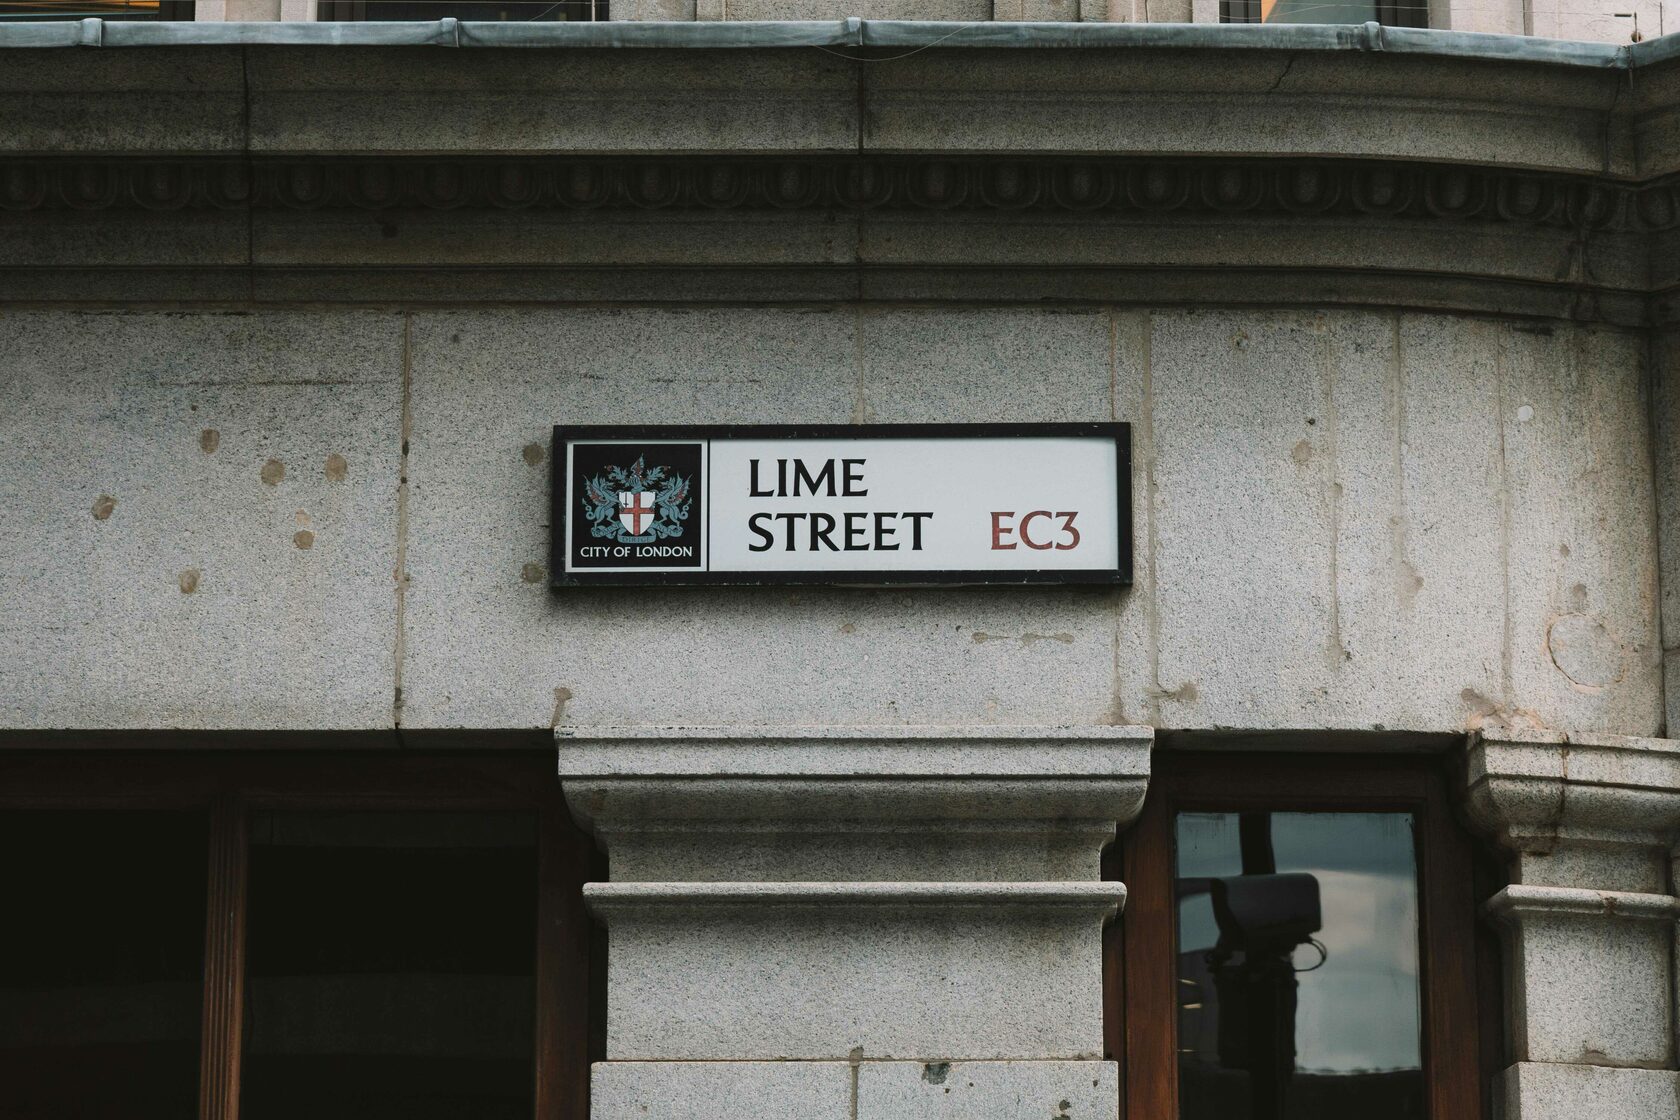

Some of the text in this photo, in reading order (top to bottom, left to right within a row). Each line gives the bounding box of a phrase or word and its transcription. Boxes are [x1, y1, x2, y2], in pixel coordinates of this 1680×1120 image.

[749, 458, 869, 498] LIME
[748, 511, 934, 553] STREET
[989, 510, 1081, 551] EC3
[580, 546, 693, 558] CITY OF LONDON
